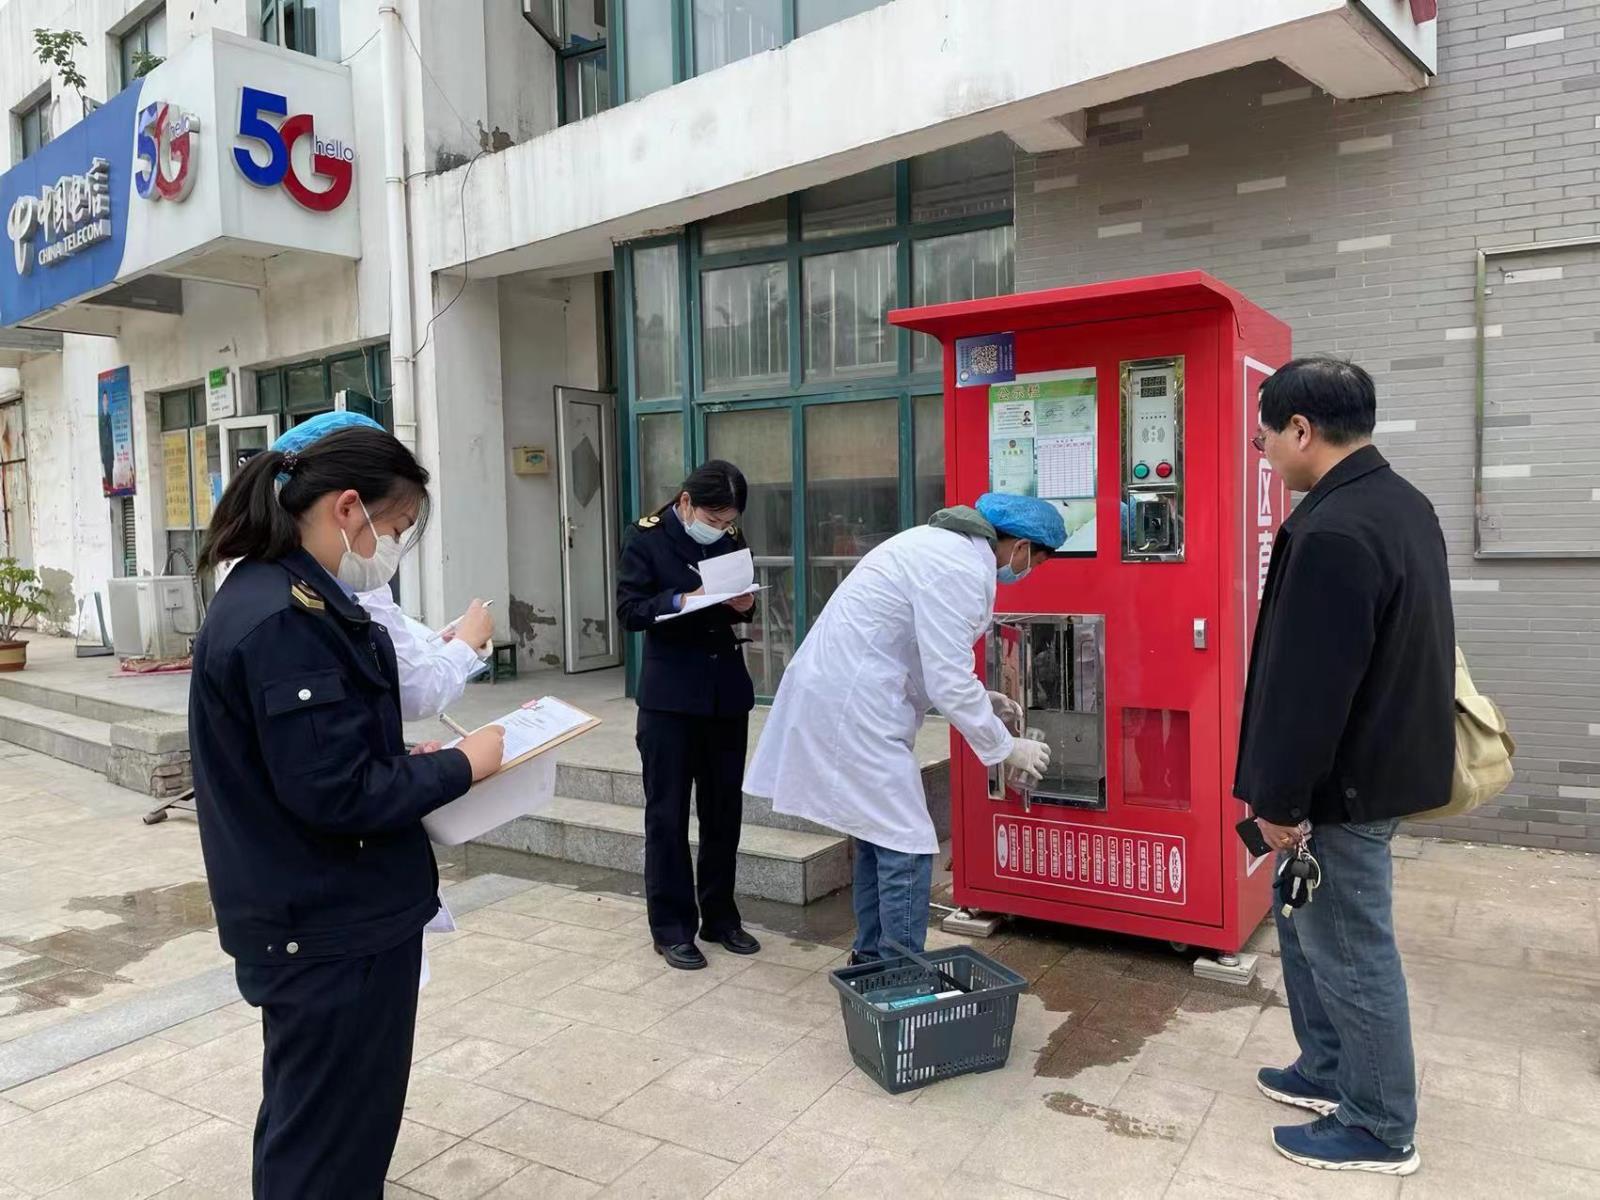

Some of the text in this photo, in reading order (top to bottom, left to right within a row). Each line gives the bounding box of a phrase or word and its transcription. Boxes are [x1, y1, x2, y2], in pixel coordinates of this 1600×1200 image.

[135, 102, 192, 201] 5G
[232, 86, 353, 212] 5G
[315, 135, 355, 161] hello
[37, 157, 109, 243] 中国电信
[38, 221, 104, 266] CHINA TELECOM
[998, 384, 1041, 401] 公示栏
